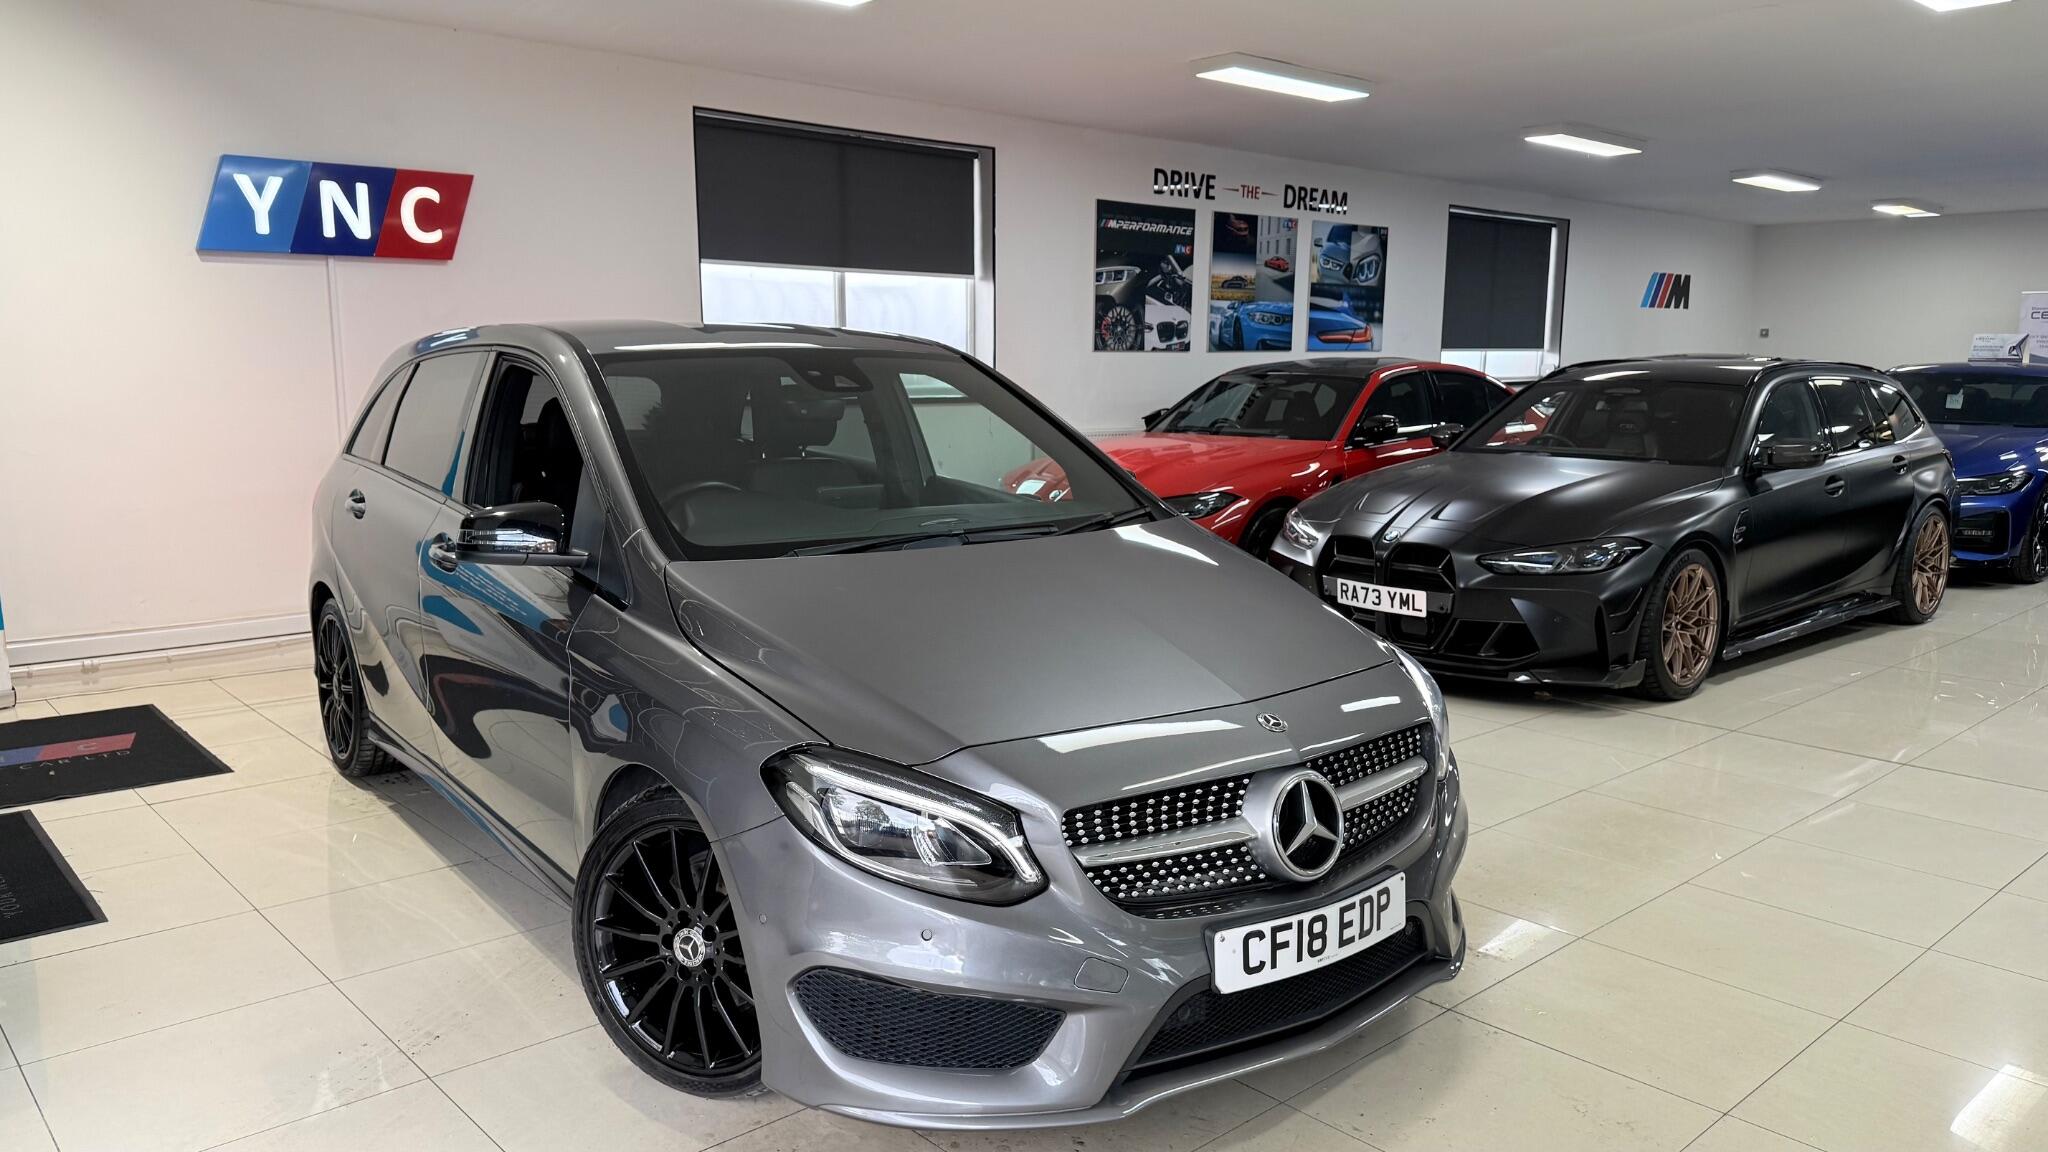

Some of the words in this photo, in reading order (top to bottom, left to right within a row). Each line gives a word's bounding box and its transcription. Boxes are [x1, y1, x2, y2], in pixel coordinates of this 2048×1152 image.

[233, 173, 443, 244] YNC
[1153, 168, 1216, 200] DRIVE
[1240, 184, 1260, 200] THE
[1283, 184, 1348, 215] DREAM
[1340, 583, 1382, 606] RA73
[1387, 590, 1422, 612] YML
[1242, 913, 1328, 975] CF18
[1338, 886, 1391, 949] EDP
